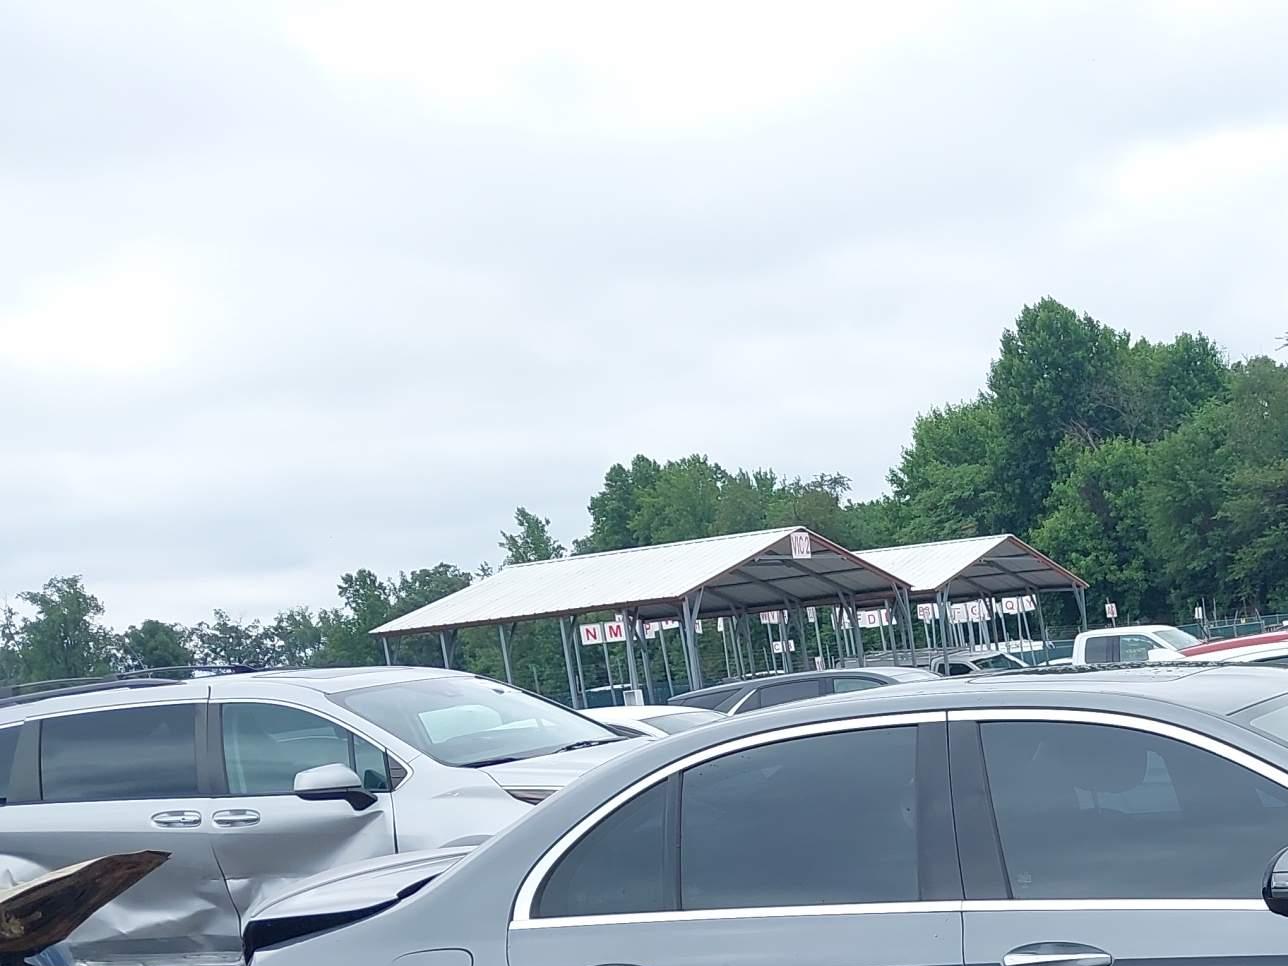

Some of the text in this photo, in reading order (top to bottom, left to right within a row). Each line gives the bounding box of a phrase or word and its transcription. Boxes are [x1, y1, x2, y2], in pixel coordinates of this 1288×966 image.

[867, 614, 876, 625] D
[584, 627, 597, 641] N
[608, 624, 622, 638] M
